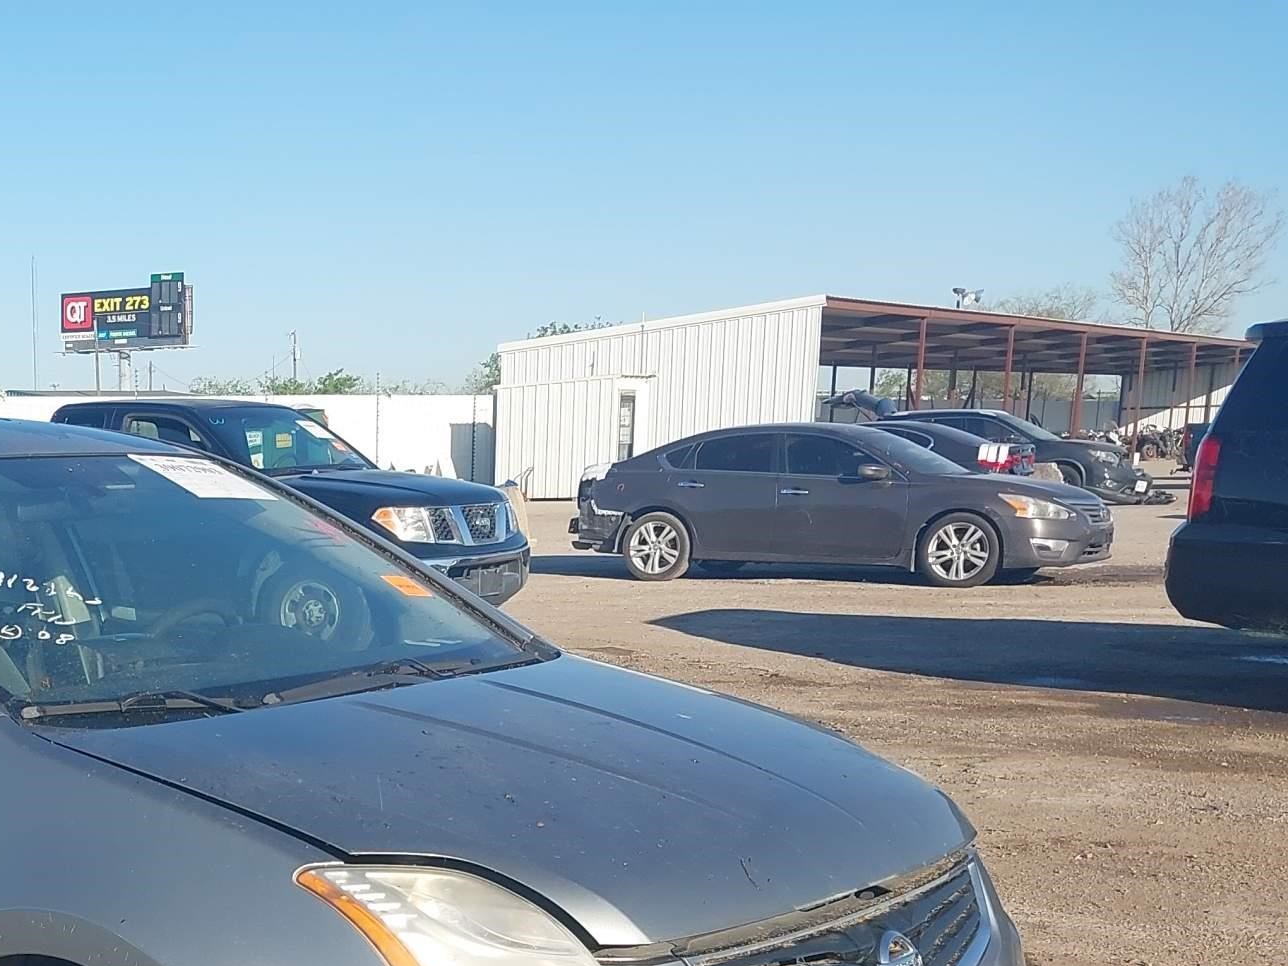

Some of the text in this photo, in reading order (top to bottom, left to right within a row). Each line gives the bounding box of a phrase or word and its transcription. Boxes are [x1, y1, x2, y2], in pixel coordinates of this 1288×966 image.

[94, 295, 150, 312] EXIT 273
[66, 301, 88, 324] QT
[117, 314, 136, 322] MILES
